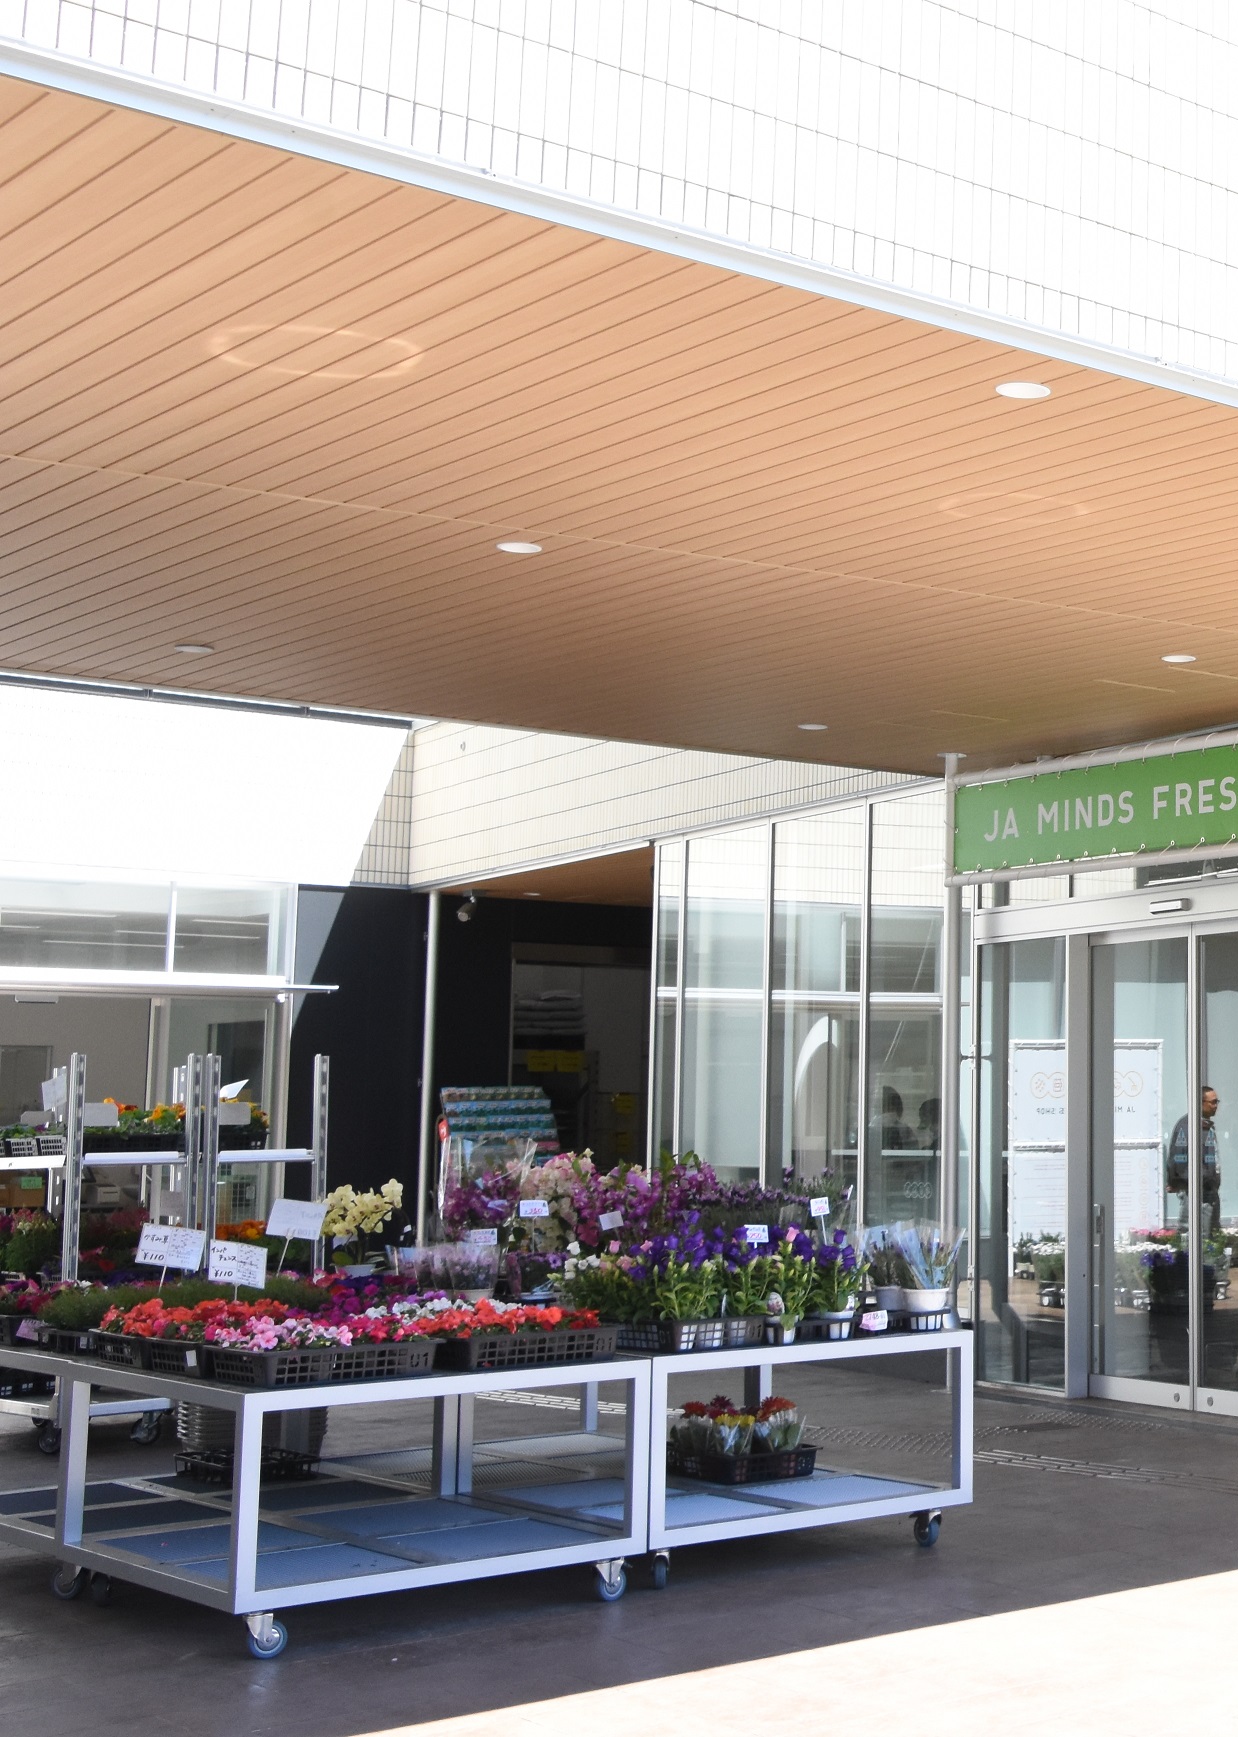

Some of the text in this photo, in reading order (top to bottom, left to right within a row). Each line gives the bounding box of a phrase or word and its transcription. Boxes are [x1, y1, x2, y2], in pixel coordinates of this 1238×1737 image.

[983, 807, 1020, 842] JA
[1037, 790, 1135, 835] MINDS
[143, 1252, 165, 1261] ¥110
[214, 1268, 233, 1278] ¥110
